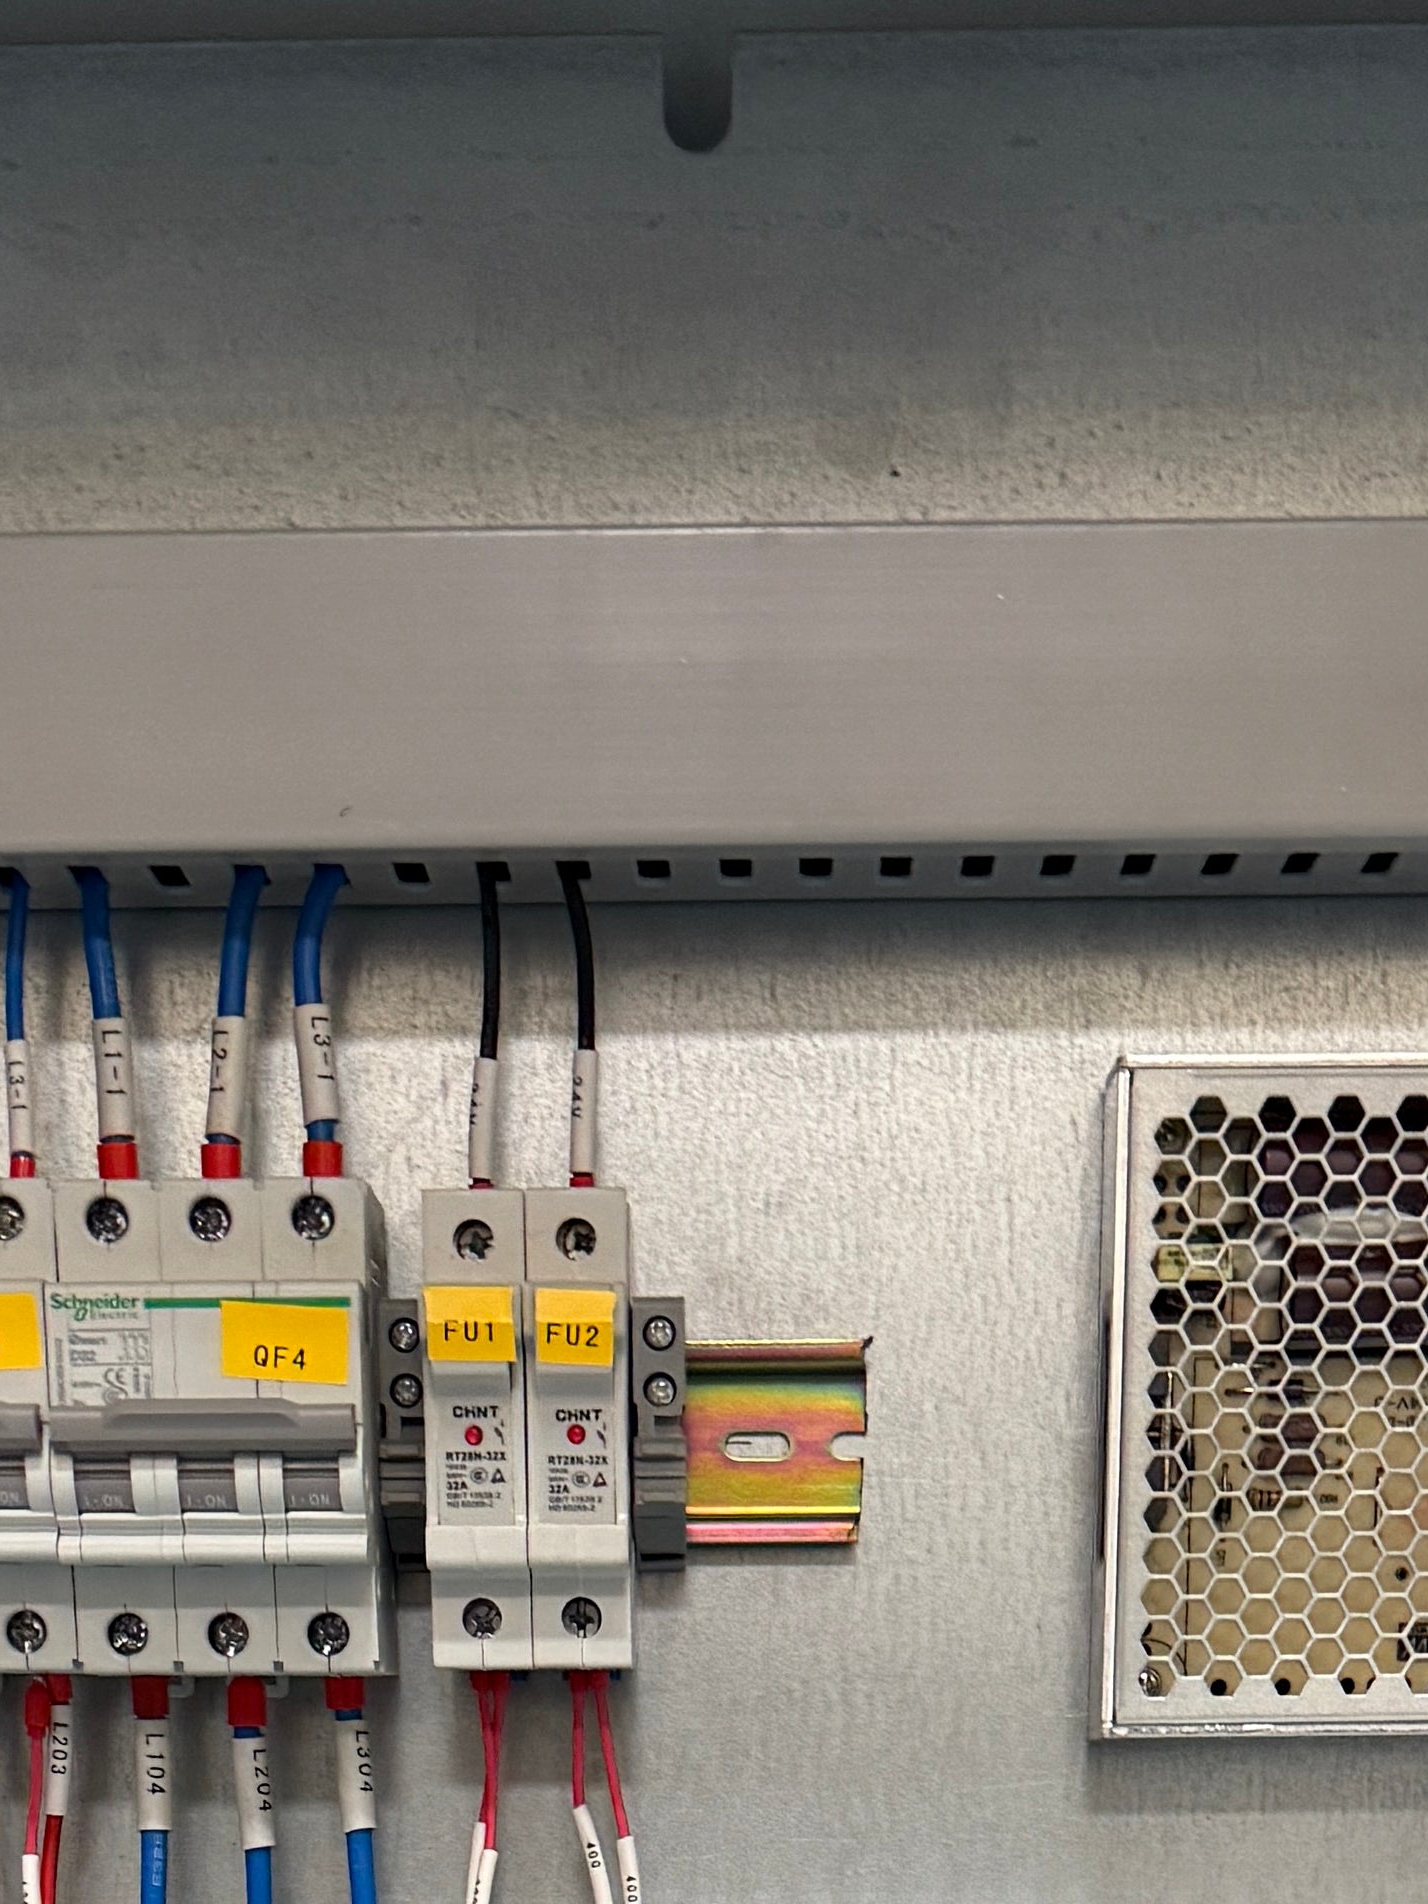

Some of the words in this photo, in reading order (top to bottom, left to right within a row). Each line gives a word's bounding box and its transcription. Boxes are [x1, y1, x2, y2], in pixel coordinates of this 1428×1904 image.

[101, 1028, 127, 1096] L1-1
[210, 1029, 229, 1095] L2-1
[310, 1015, 335, 1082] L3-1
[8, 1060, 28, 1110] L3-1
[50, 1293, 141, 1312] Schneider
[443, 1319, 495, 1342] FU1
[545, 1322, 600, 1348] FU2
[253, 1344, 307, 1371] QF4
[452, 1405, 500, 1419] CHNT
[555, 1408, 603, 1423] CHNT
[50, 1721, 69, 1776] L203
[143, 1732, 166, 1797] L104
[355, 1729, 373, 1793] L304
[253, 1747, 273, 1812] L204
[585, 1841, 601, 1869] 400
[625, 1875, 639, 1904] 400
